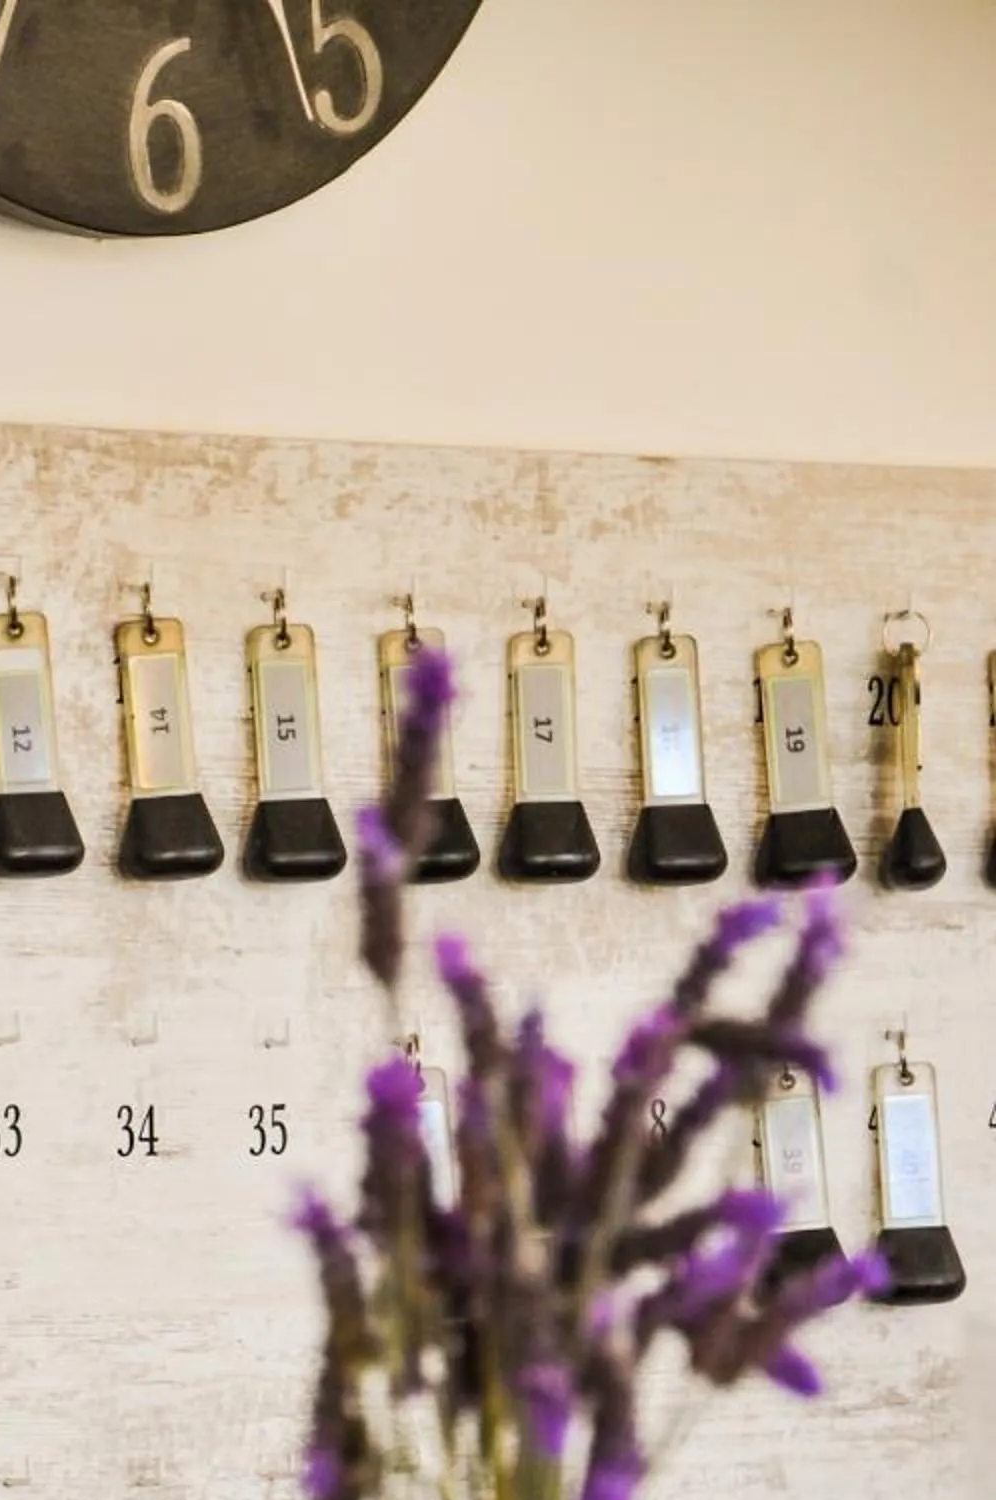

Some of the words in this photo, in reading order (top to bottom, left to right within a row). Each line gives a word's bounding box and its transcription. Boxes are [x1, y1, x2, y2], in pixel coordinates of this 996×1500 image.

[310, 0, 383, 133] 5
[128, 36, 202, 213] 6
[150, 706, 170, 734] 14
[276, 715, 297, 742] 15
[533, 717, 554, 744] 17
[11, 725, 32, 753] 12
[785, 726, 806, 753] 19
[117, 1104, 159, 1158] 34
[248, 1103, 289, 1157] 35
